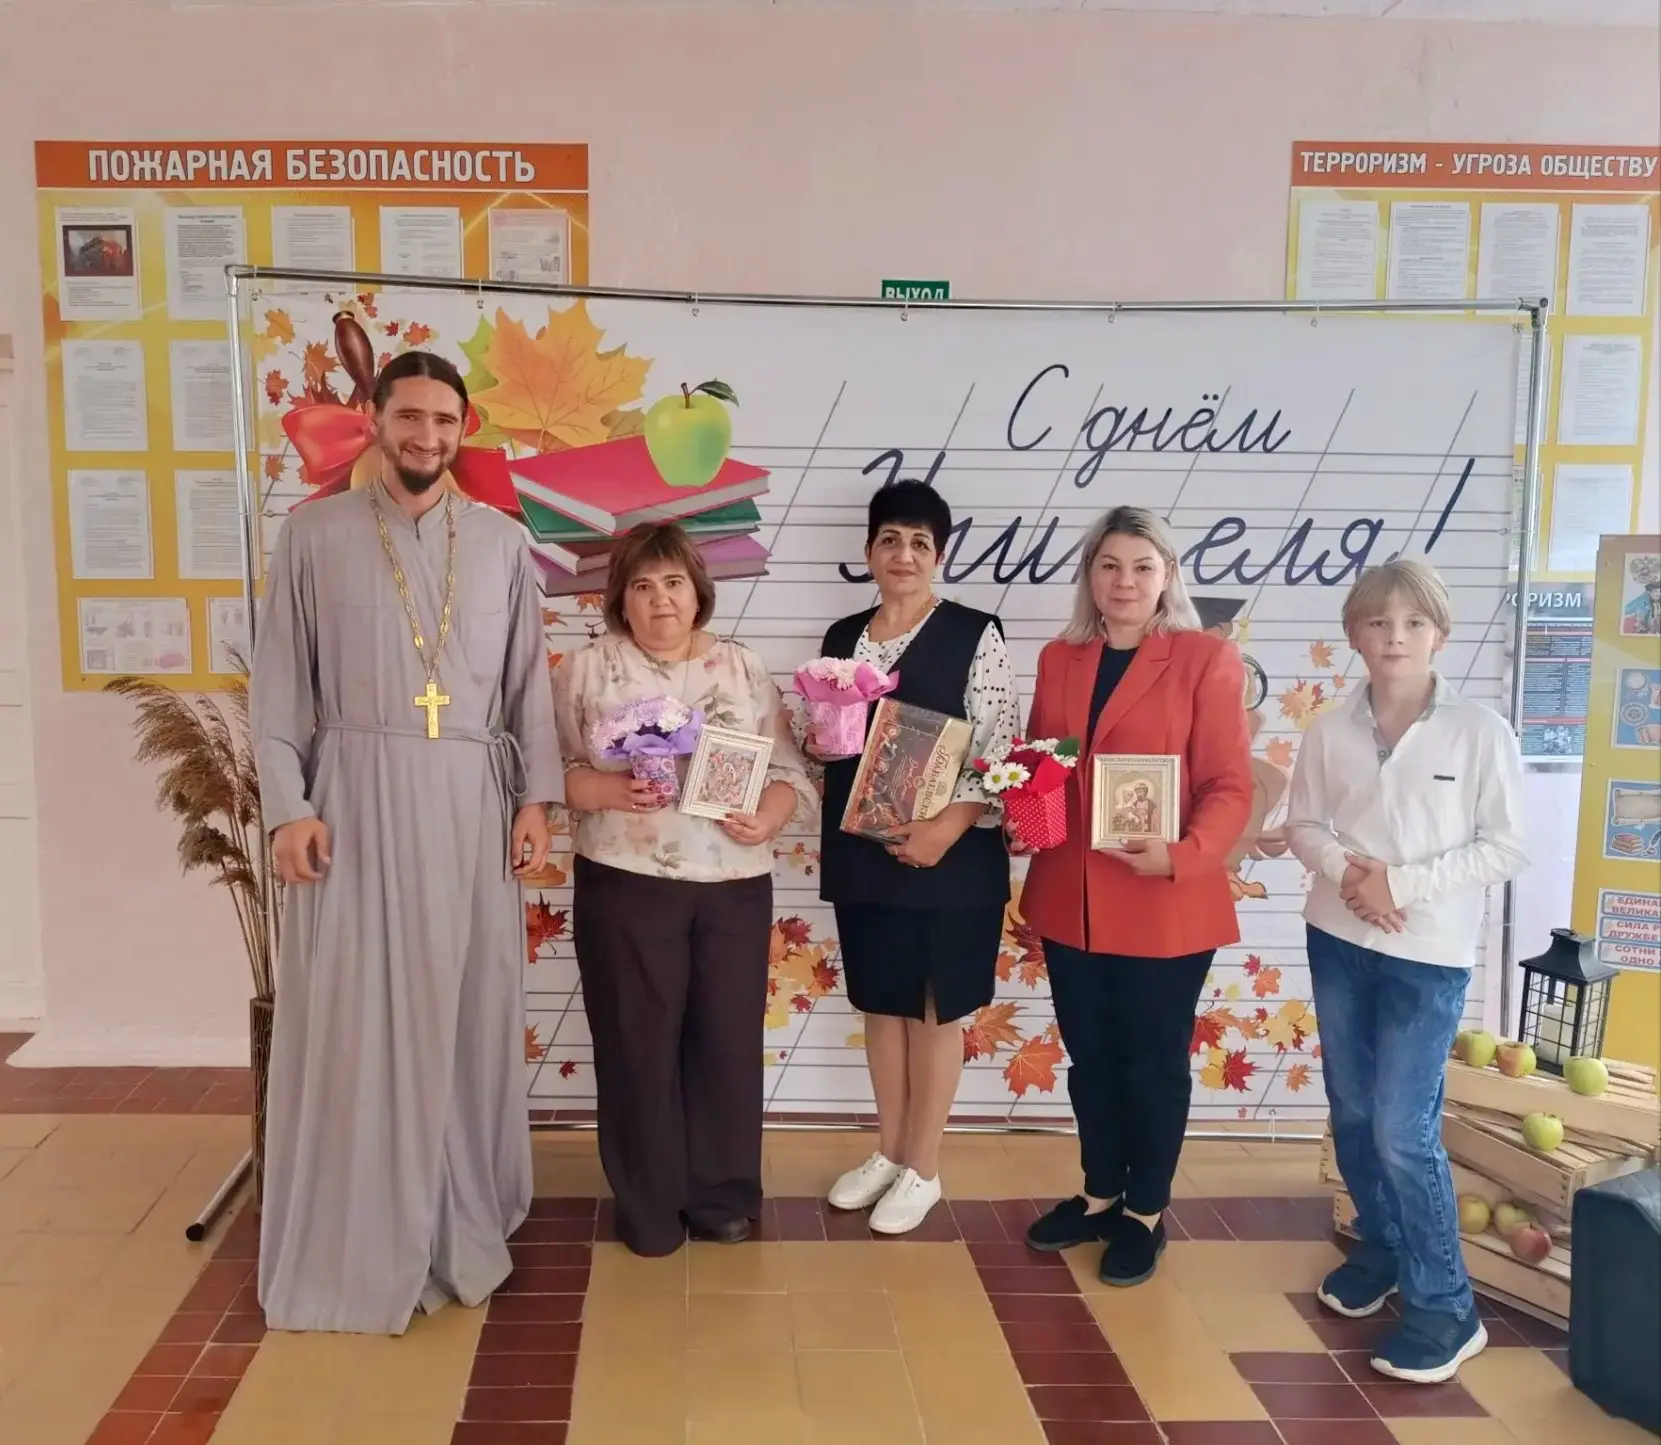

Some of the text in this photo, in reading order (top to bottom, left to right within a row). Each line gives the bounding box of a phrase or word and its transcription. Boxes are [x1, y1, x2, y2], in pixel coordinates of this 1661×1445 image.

[88, 148, 536, 183] ПОЖАРНАЯ БЕЗОПАСНОСТЬ
[1300, 151, 1427, 174] ТЕРРОРИЗМ
[1451, 153, 1532, 176] УГРОЗА
[1540, 154, 1659, 180] ОБЩЕСТВУ
[885, 286, 944, 300] ВЫХОД
[1007, 364, 1292, 488] С днём
[1617, 896, 1661, 907] ЕДИНА
[1611, 906, 1661, 917] ВЕЛИКА
[1616, 921, 1649, 930] СИЛА
[1615, 945, 1656, 955] СОТНИ
[1621, 955, 1655, 966] ОДНО
